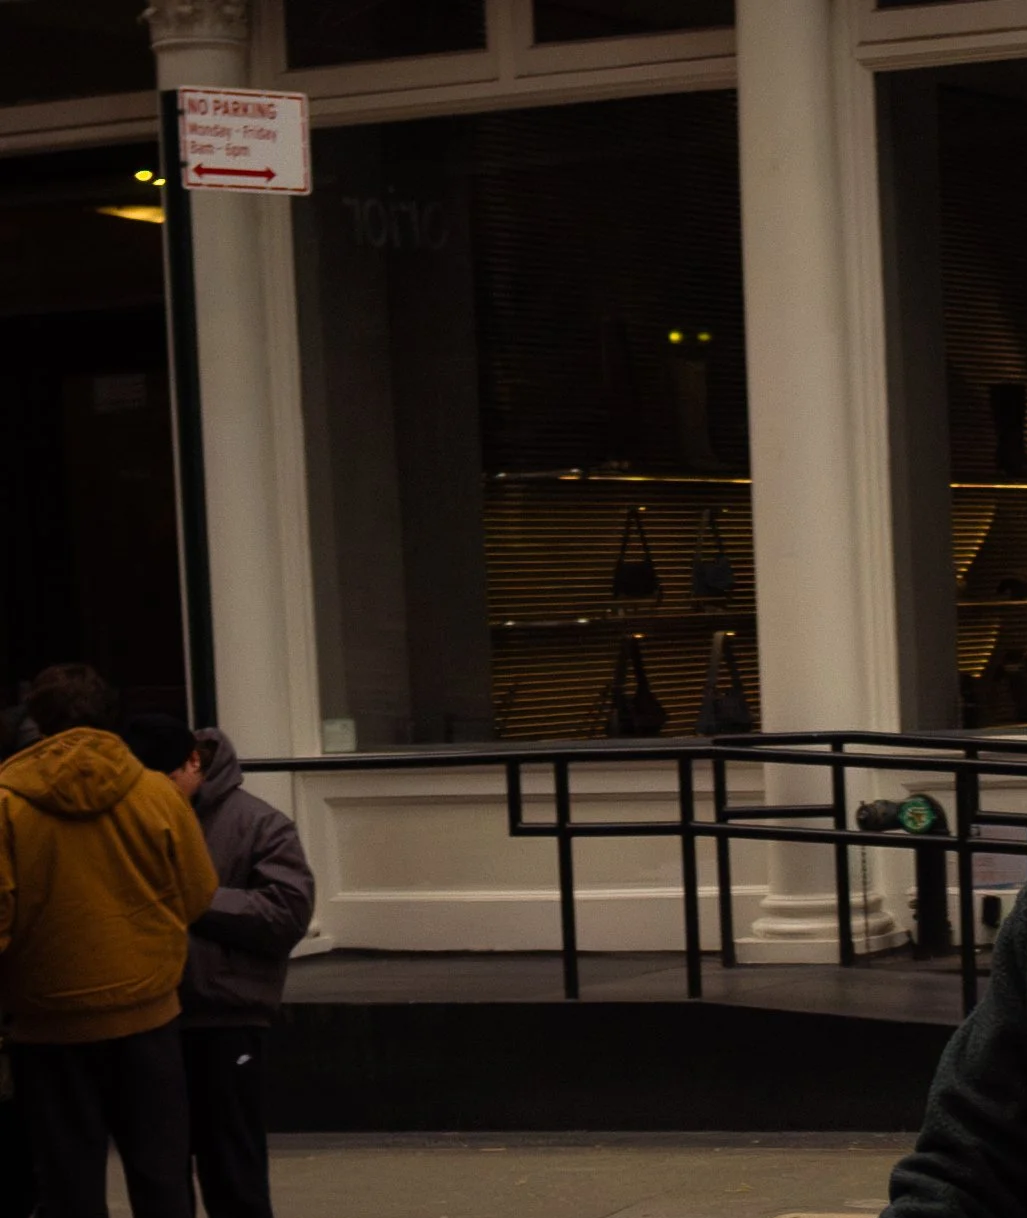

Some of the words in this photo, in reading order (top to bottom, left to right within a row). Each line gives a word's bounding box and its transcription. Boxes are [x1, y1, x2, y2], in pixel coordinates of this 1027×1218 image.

[187, 97, 208, 116] NO
[212, 99, 277, 120] PARKING
[188, 122, 231, 141] Monday
[242, 125, 277, 143] Friday
